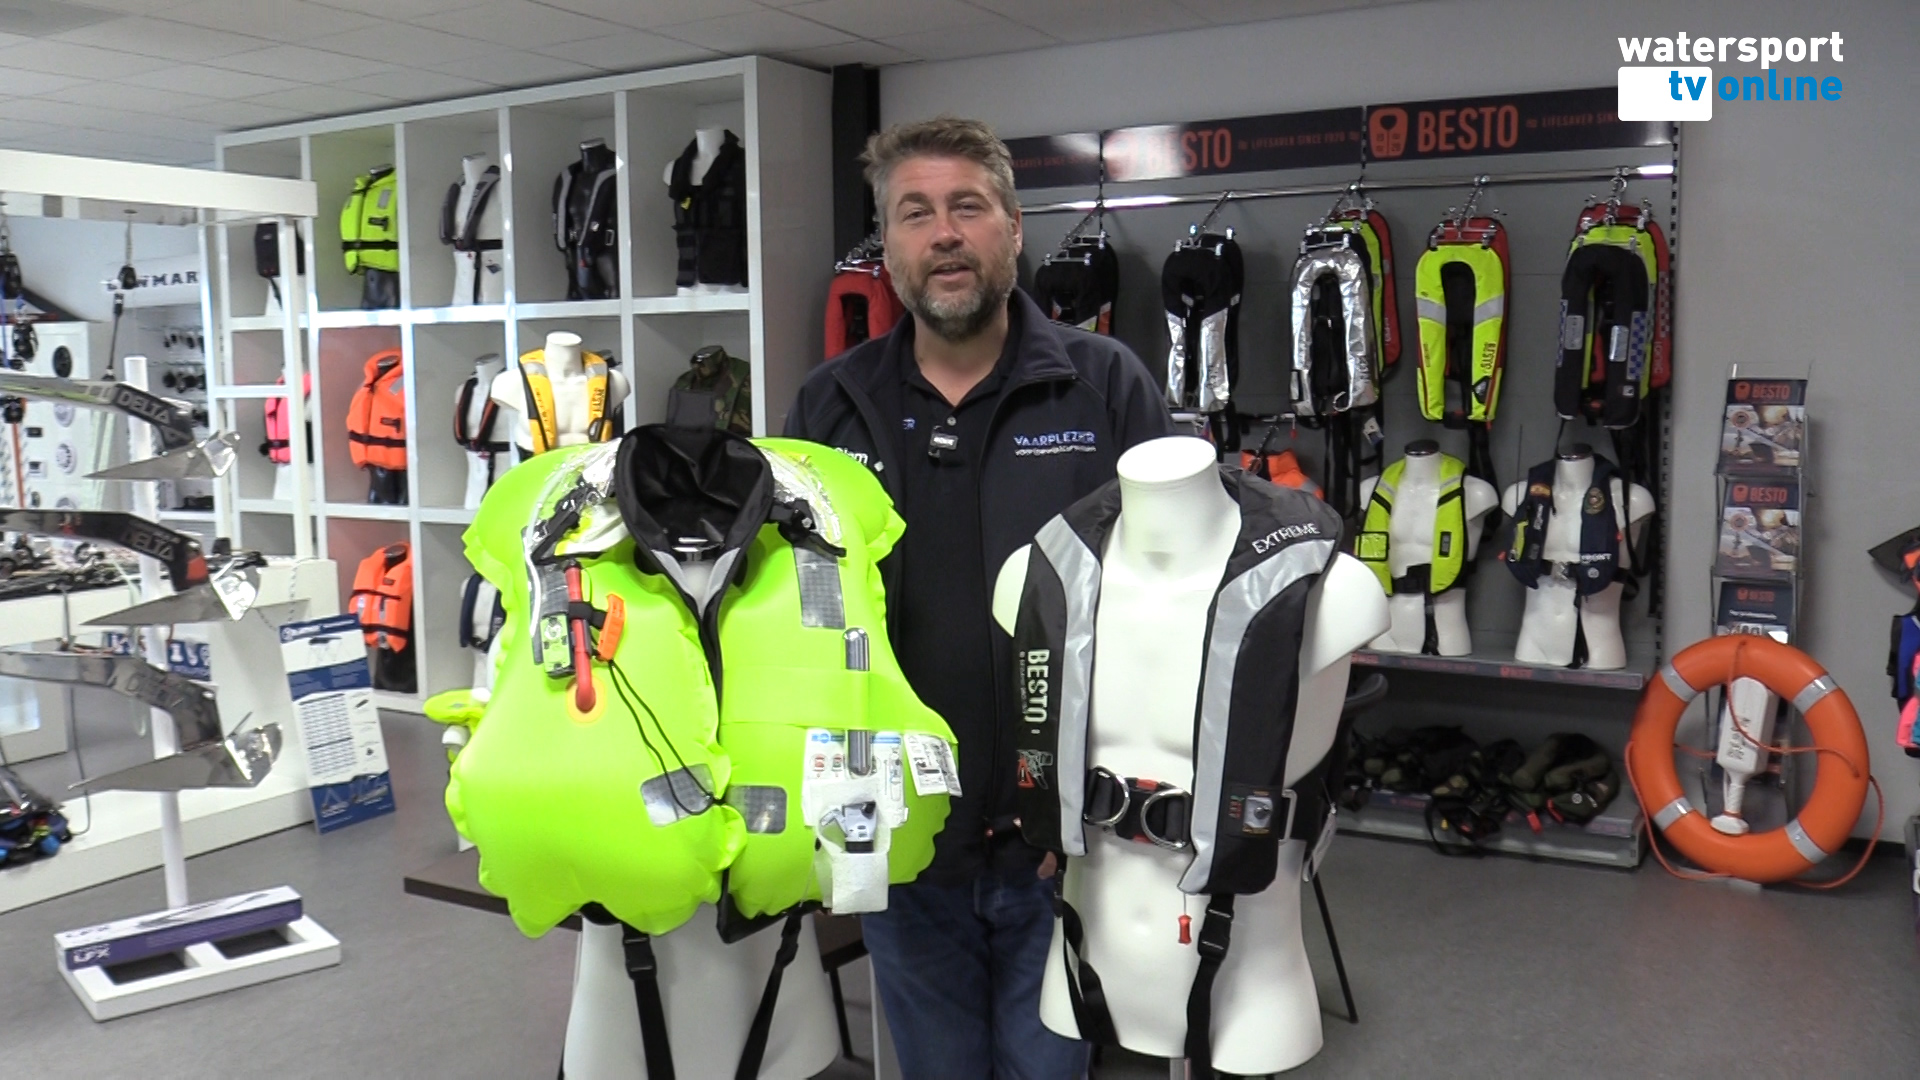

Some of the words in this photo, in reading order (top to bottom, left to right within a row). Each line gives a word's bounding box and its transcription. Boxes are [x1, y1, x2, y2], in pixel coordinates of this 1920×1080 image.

[1417, 104, 1519, 153] BESTO
[117, 389, 169, 425] DELTA
[1752, 383, 1791, 401] BESTO
[1750, 486, 1788, 504] BESTO
[1251, 522, 1321, 554] EXTREME
[1024, 649, 1050, 723] BESTO
